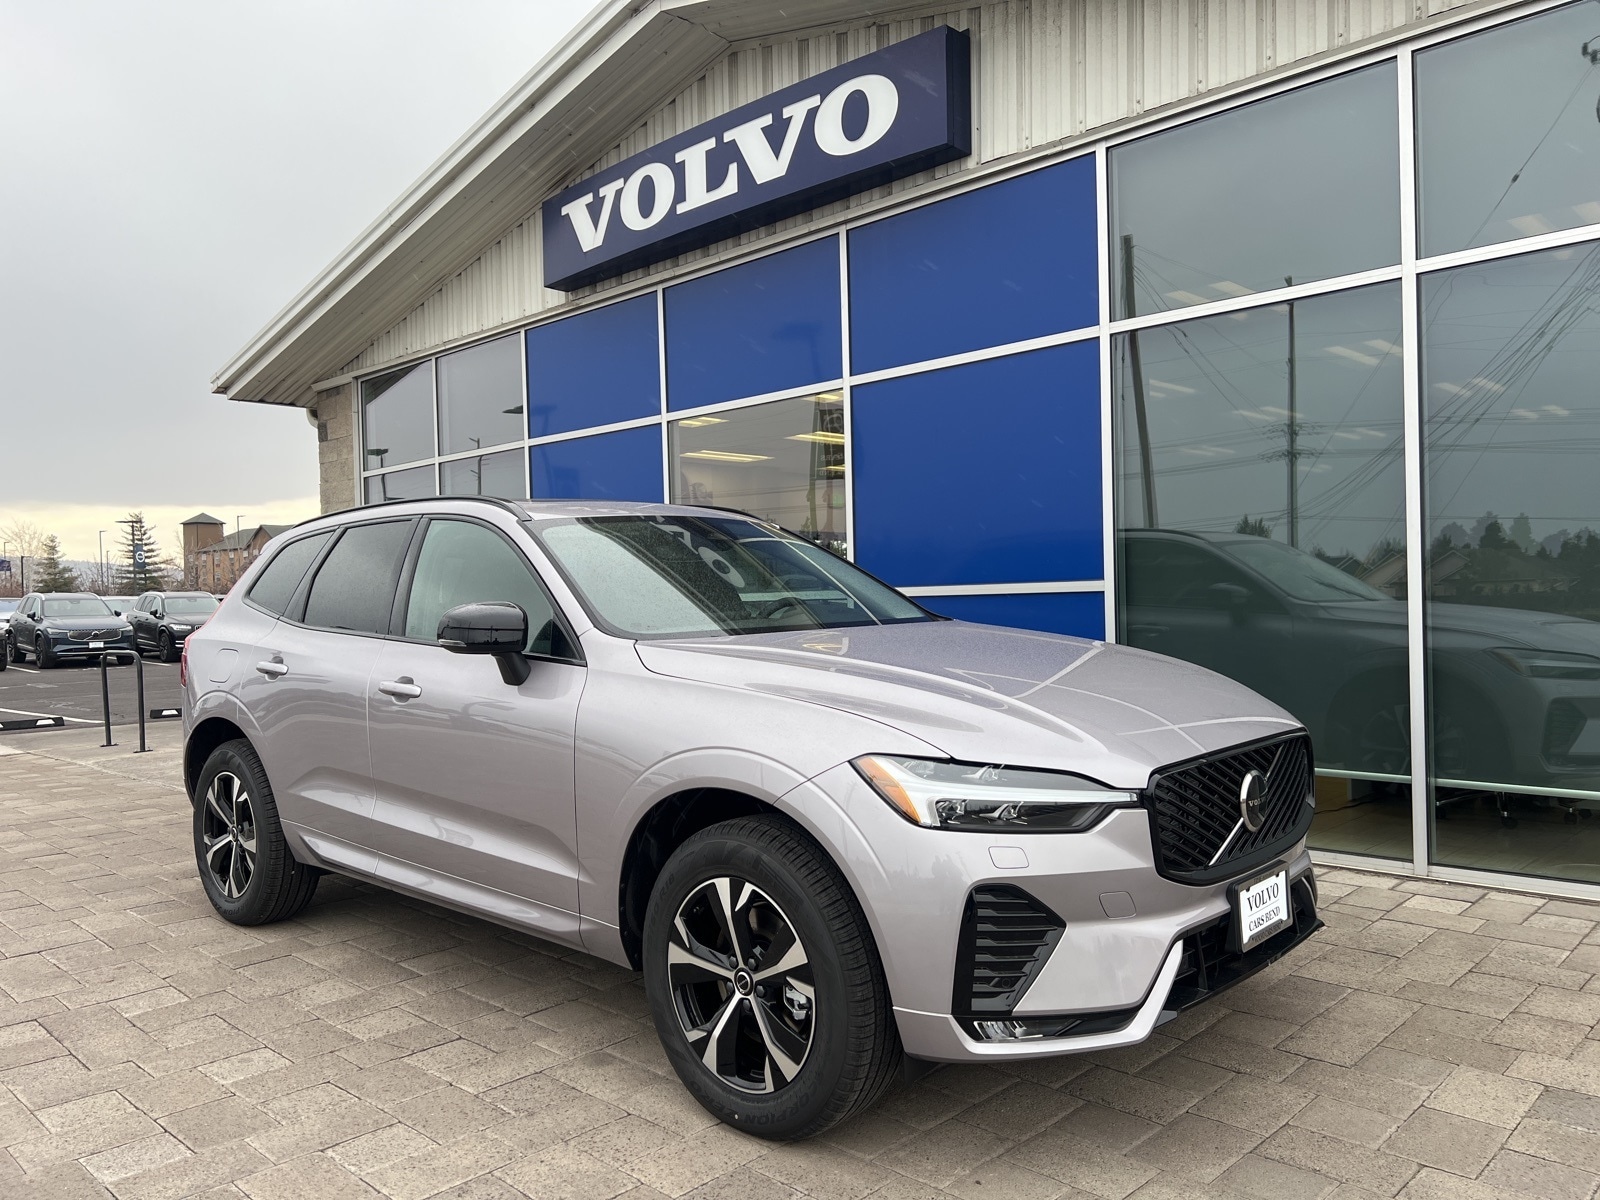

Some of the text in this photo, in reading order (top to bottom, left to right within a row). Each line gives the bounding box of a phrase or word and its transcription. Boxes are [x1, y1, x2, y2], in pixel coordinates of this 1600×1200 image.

[561, 74, 899, 253] VOLVO
[1247, 883, 1279, 911] VOLVO
[1248, 916, 1264, 932] CARS
[1265, 906, 1281, 924] BEND
